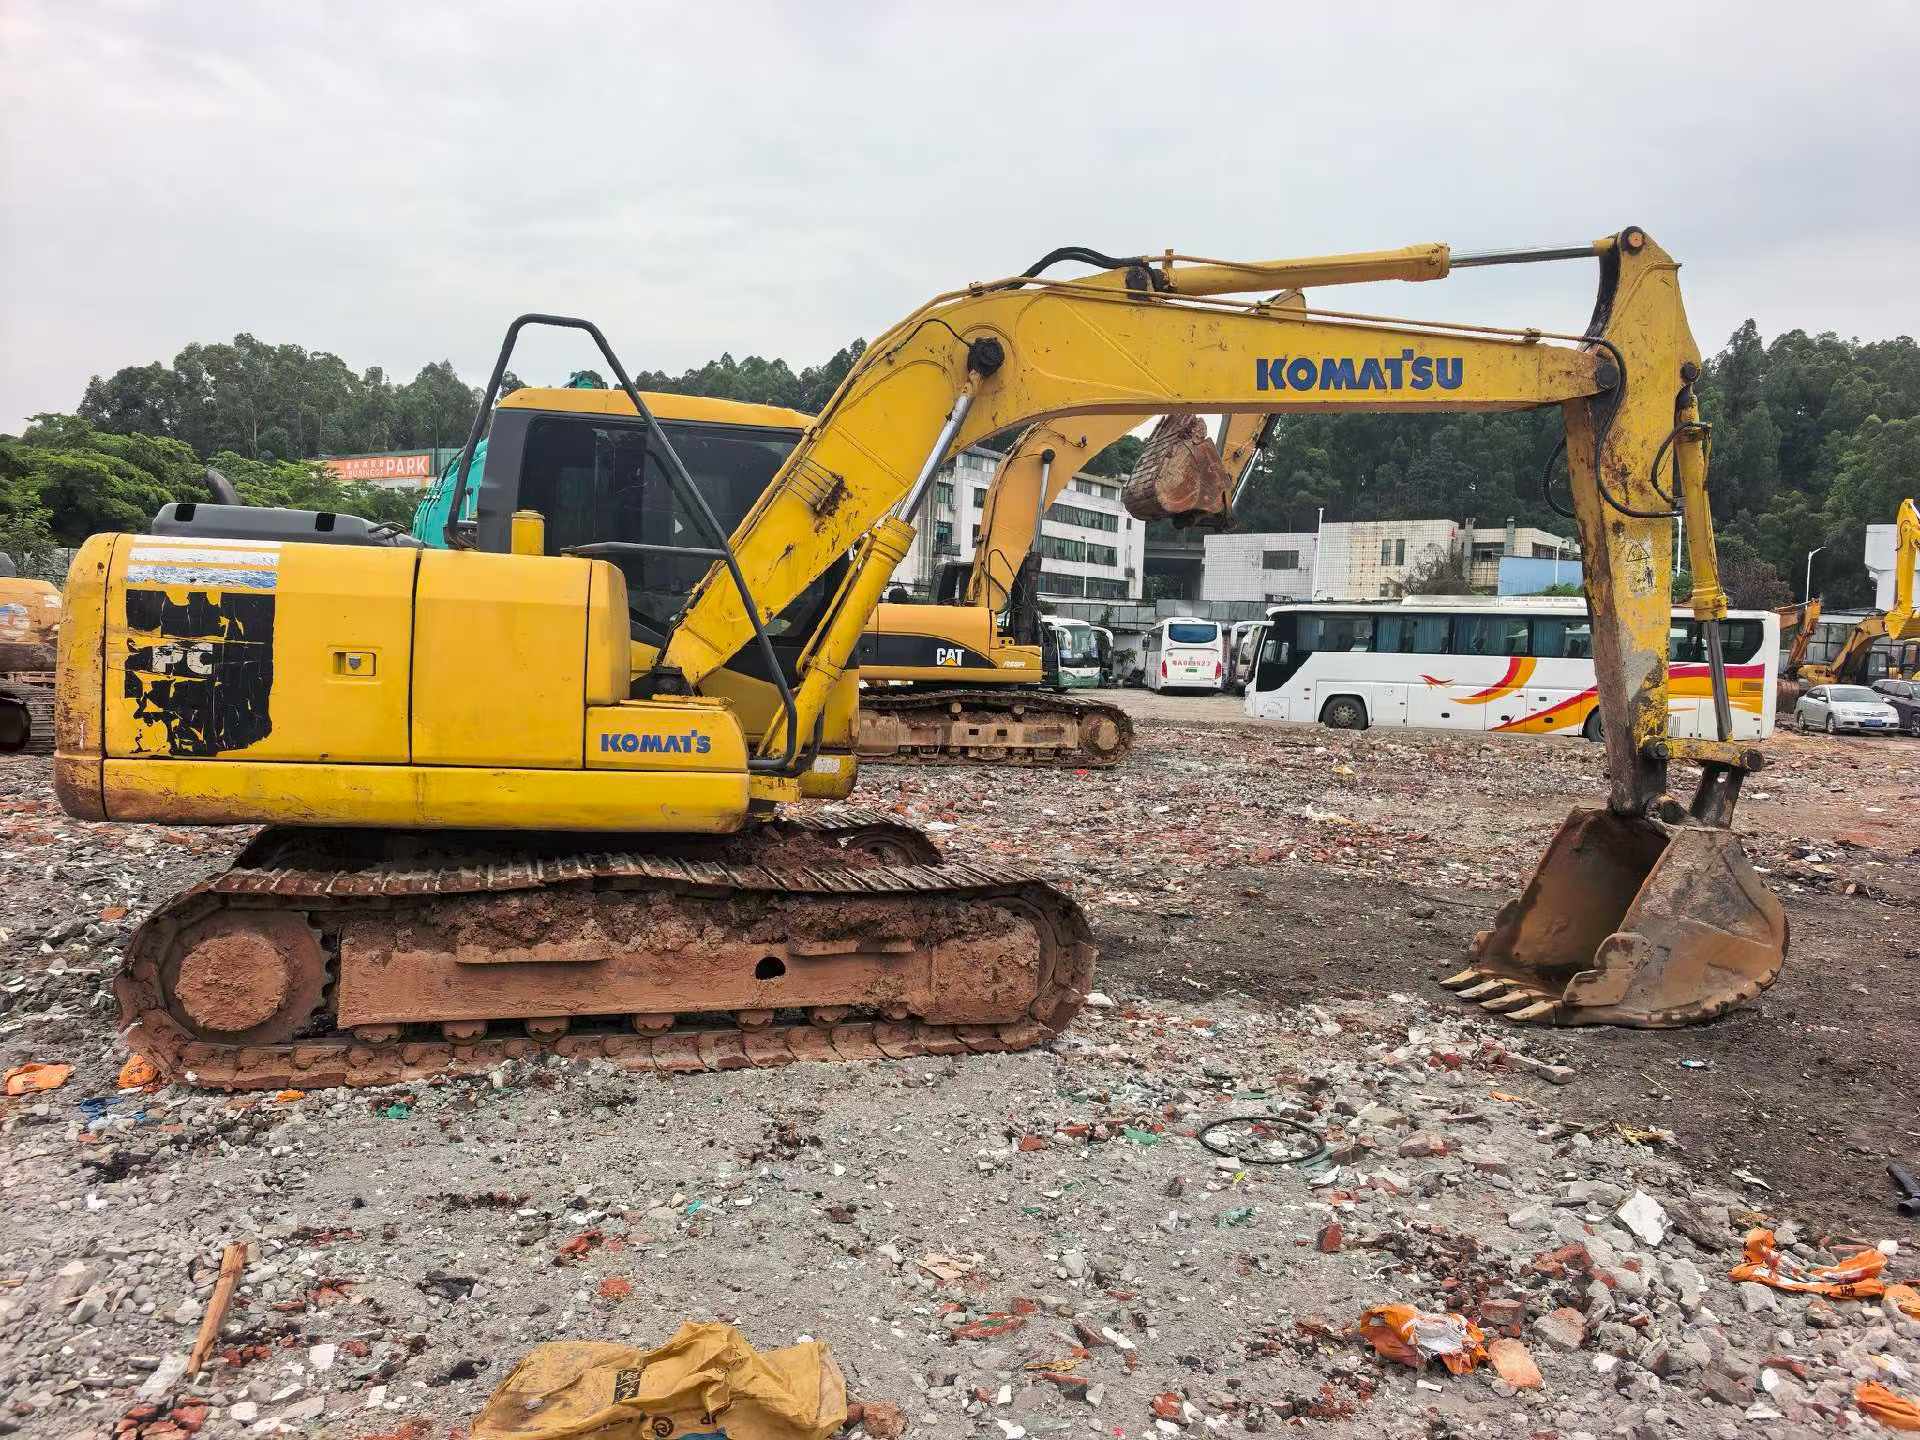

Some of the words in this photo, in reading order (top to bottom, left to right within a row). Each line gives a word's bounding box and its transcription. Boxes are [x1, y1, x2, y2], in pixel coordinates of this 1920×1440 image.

[1256, 349, 1463, 391] KOMATSU
[386, 457, 426, 475] PARK
[152, 642, 213, 675] PC
[936, 648, 965, 666] CAT
